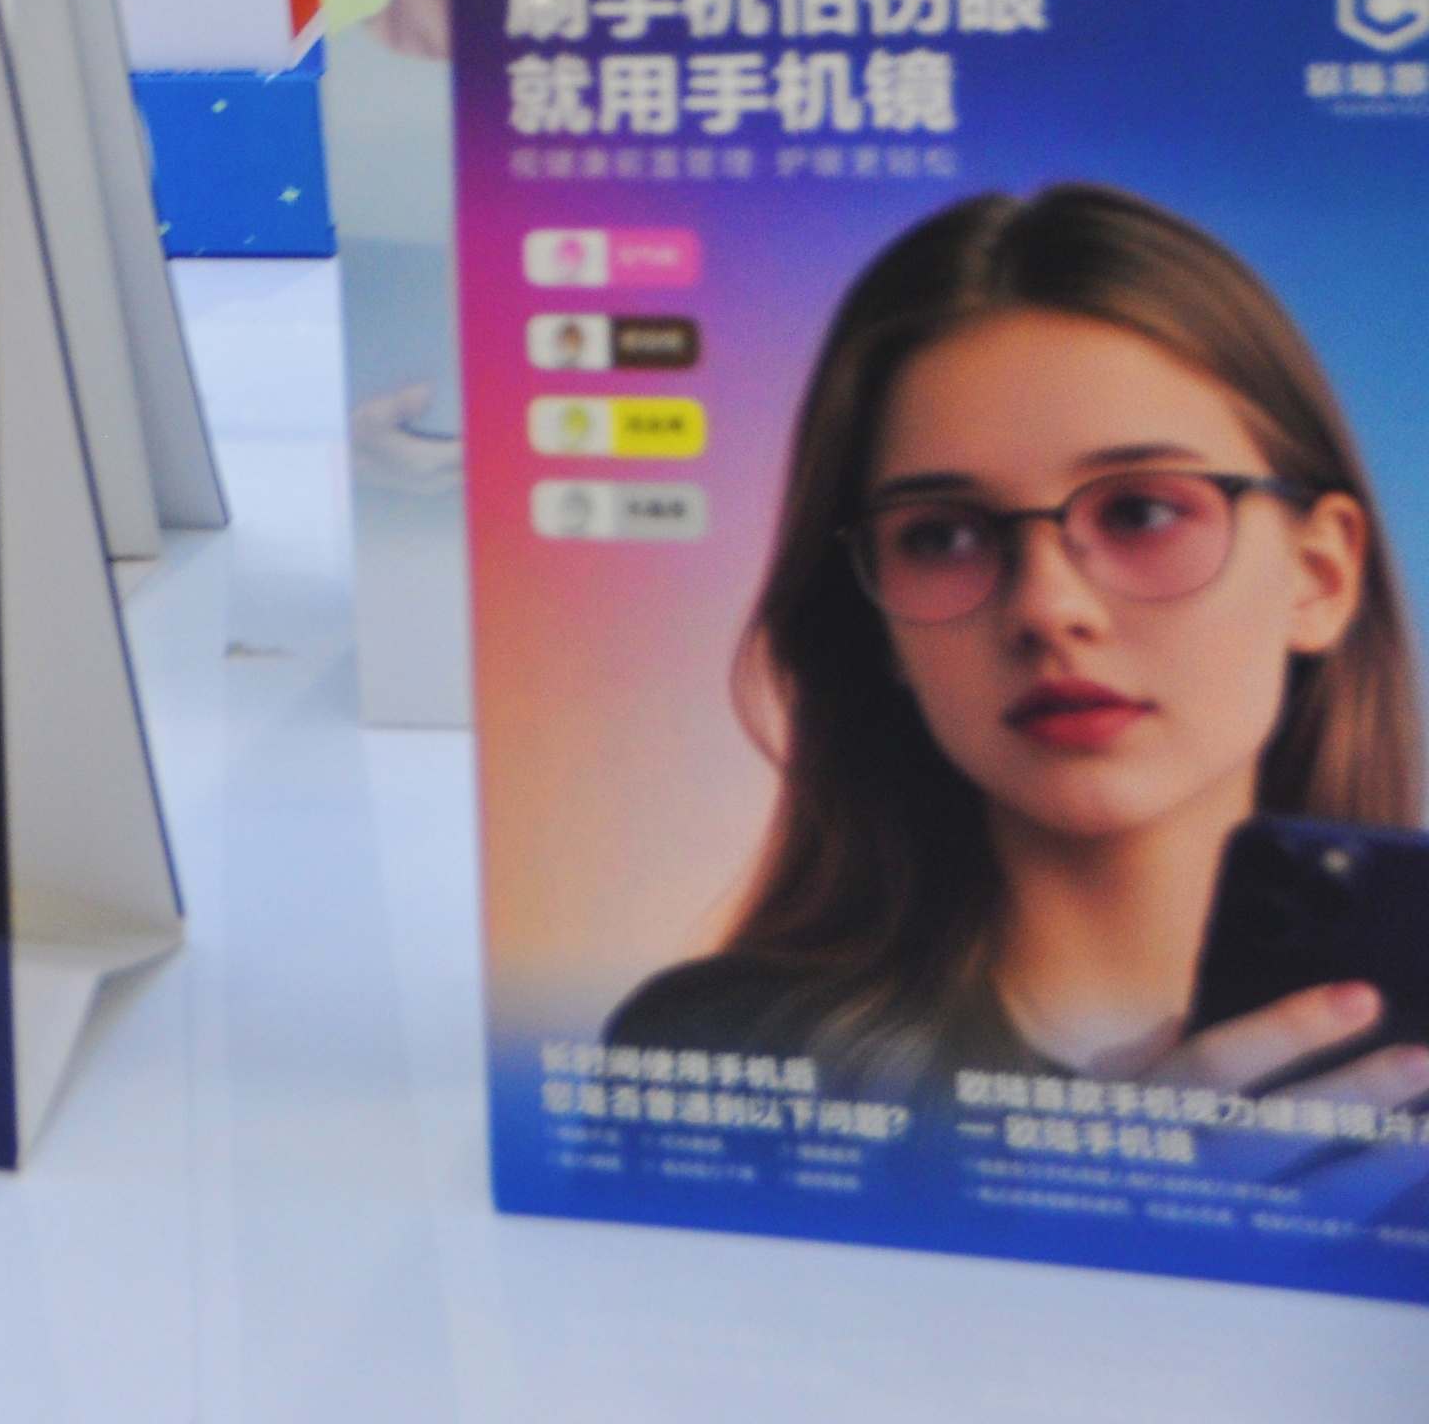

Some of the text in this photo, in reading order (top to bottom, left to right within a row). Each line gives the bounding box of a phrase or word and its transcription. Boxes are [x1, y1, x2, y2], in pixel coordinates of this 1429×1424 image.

[508, 50, 956, 134] 就用手机镜
